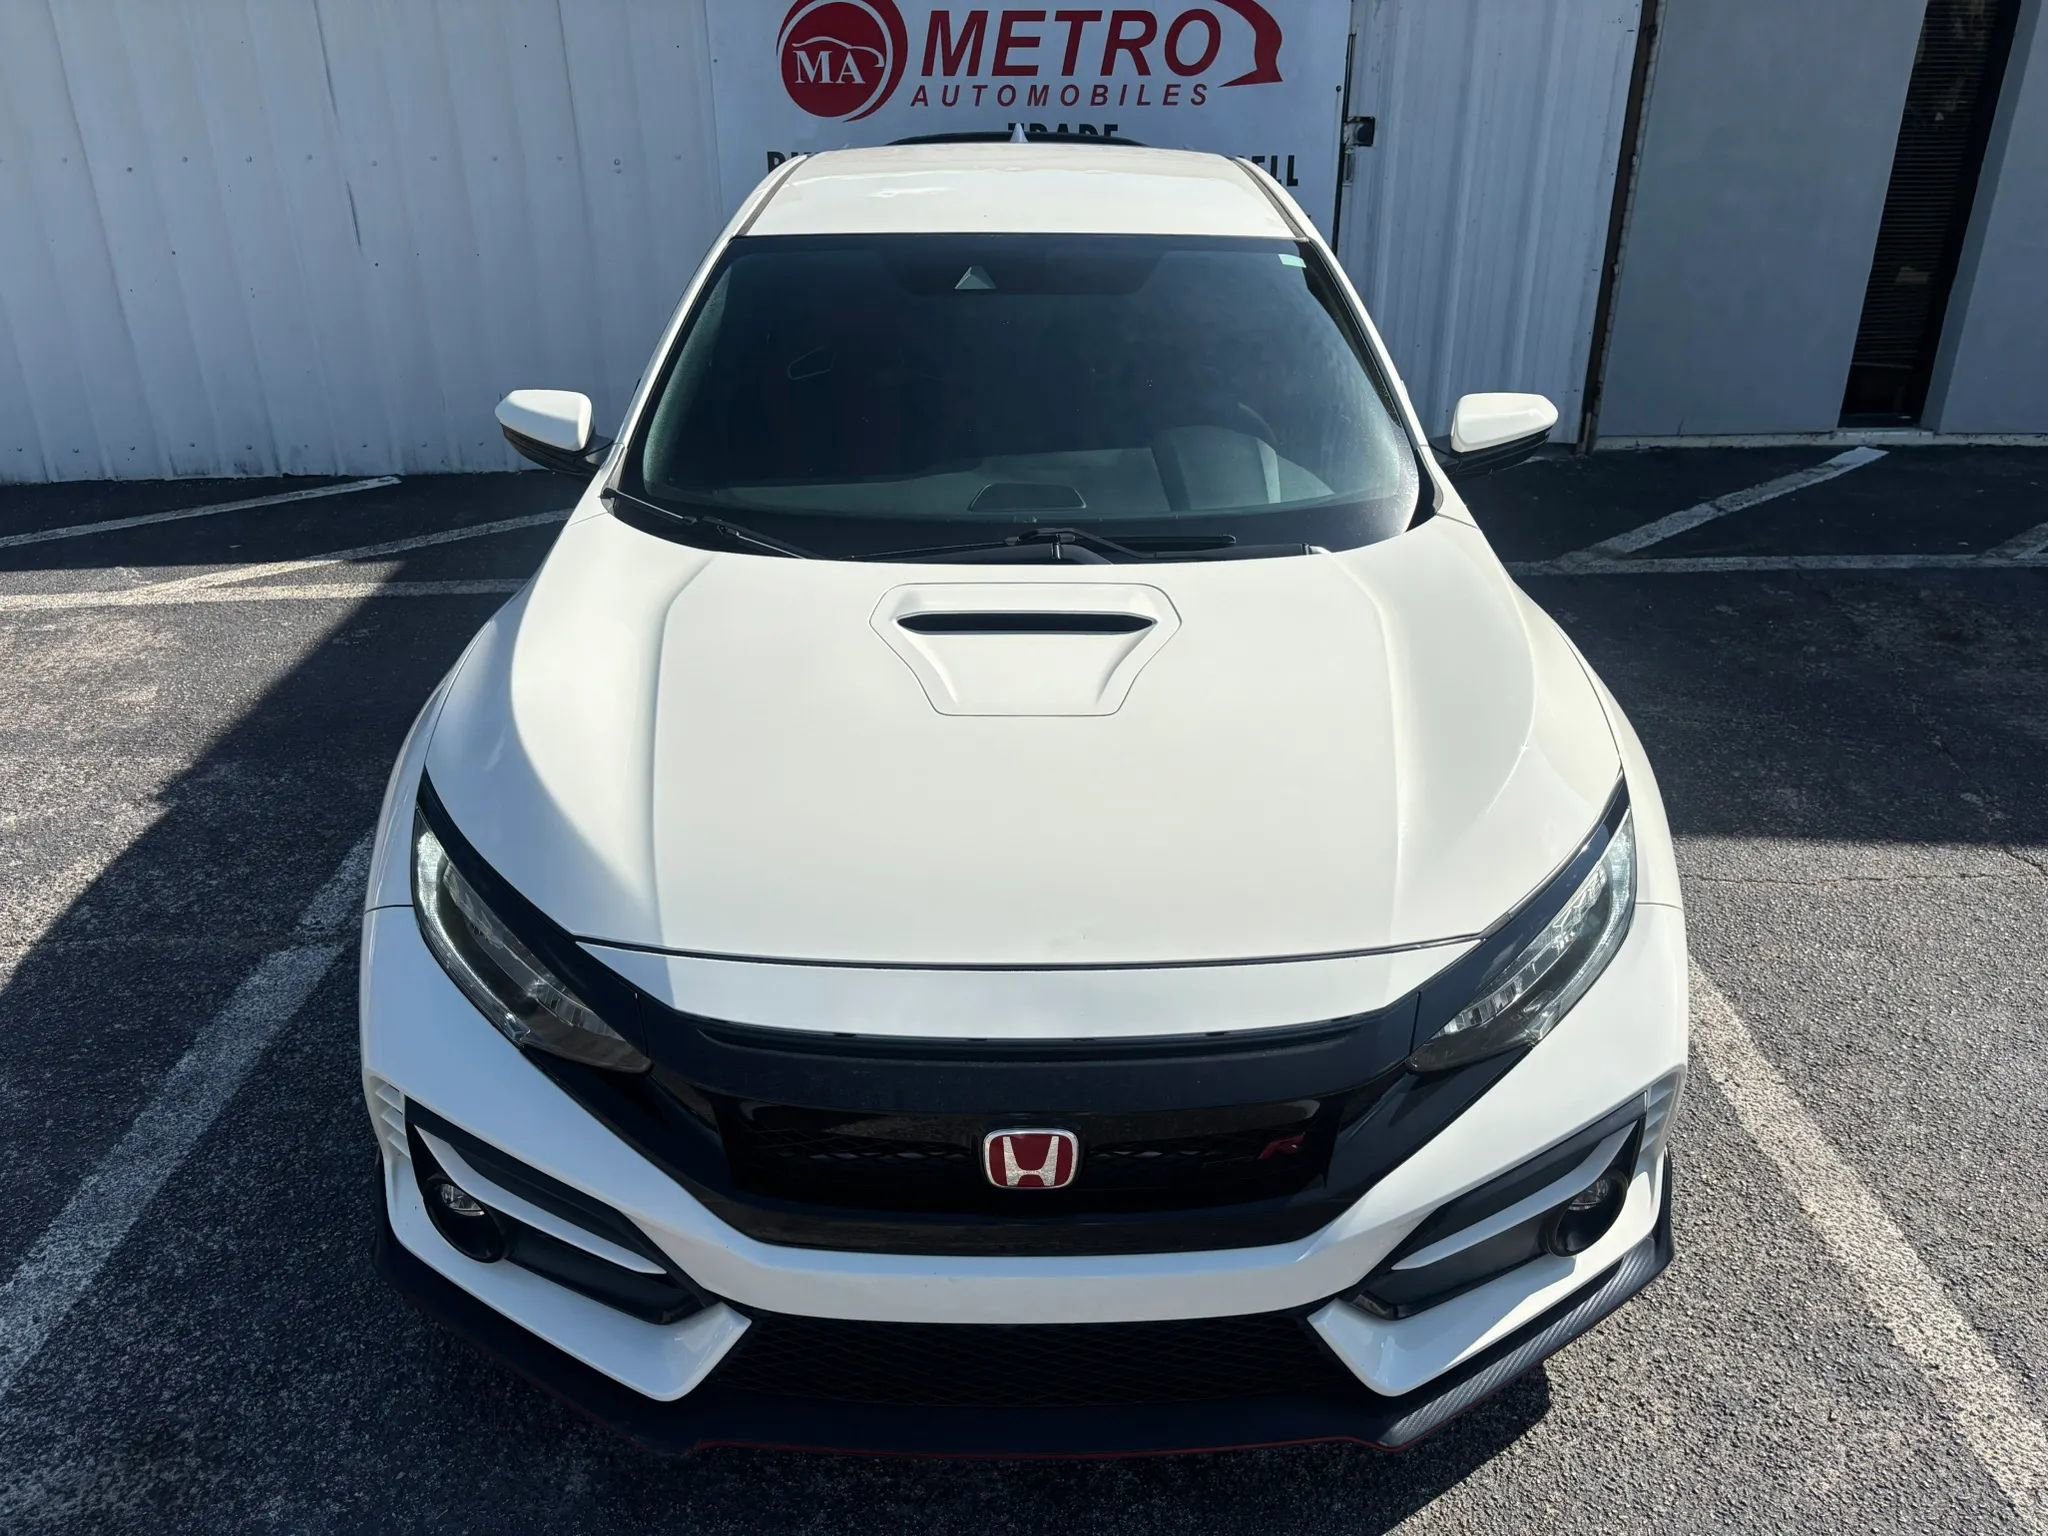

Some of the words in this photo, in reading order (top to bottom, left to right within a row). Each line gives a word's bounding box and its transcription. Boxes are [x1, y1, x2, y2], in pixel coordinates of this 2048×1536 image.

[921, 9, 1222, 77] METRO
[792, 50, 866, 84] MA
[909, 83, 1208, 108] AUTOMOBILES
